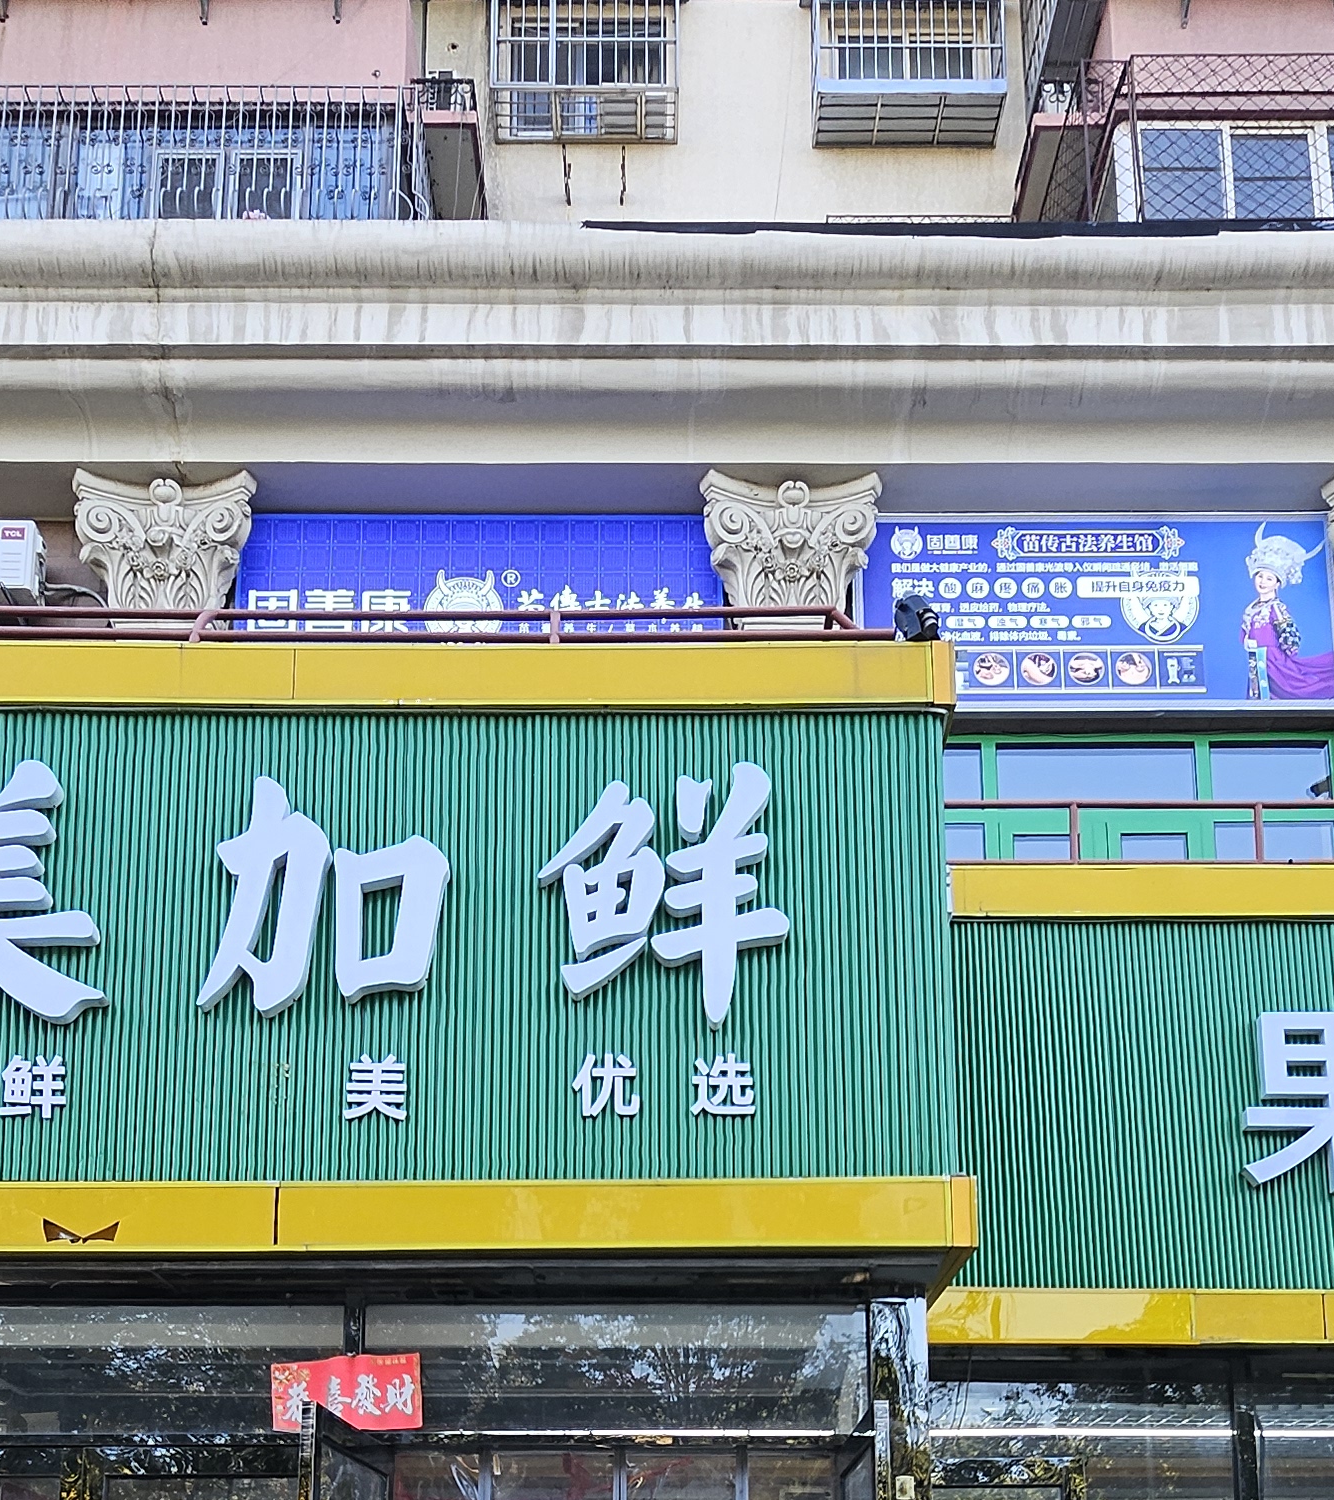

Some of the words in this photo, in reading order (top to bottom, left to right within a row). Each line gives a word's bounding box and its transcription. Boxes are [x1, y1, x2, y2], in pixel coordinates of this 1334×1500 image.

[3, 528, 25, 538] TCL
[1021, 534, 1155, 552] 苗传古法养生馆
[1091, 580, 1186, 593] 提升自身免疫力
[343, 1053, 410, 1121] 美
[572, 1051, 758, 1120] 优选
